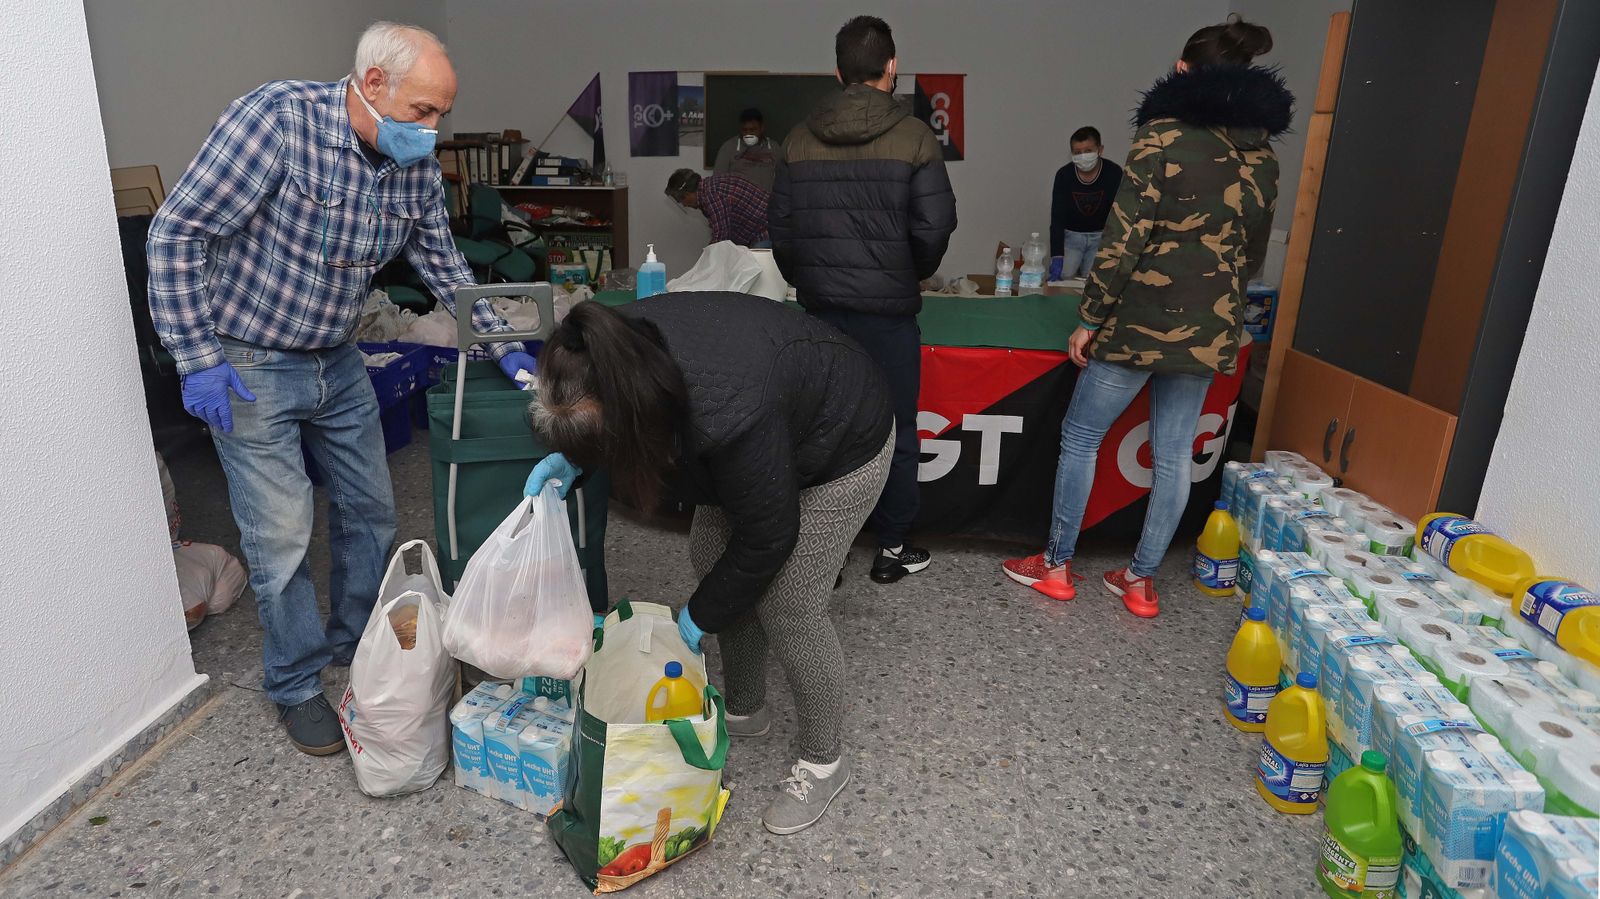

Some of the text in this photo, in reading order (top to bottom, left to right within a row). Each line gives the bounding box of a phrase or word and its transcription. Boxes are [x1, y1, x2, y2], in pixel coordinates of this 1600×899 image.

[930, 91, 950, 146] CGT
[916, 411, 1023, 485] GT
[1117, 400, 1238, 488] CG
[467, 743, 480, 751] UHT
[504, 753, 518, 762] UHT
[542, 767, 556, 777] UHT
[1501, 845, 1539, 890] Leche UHT
